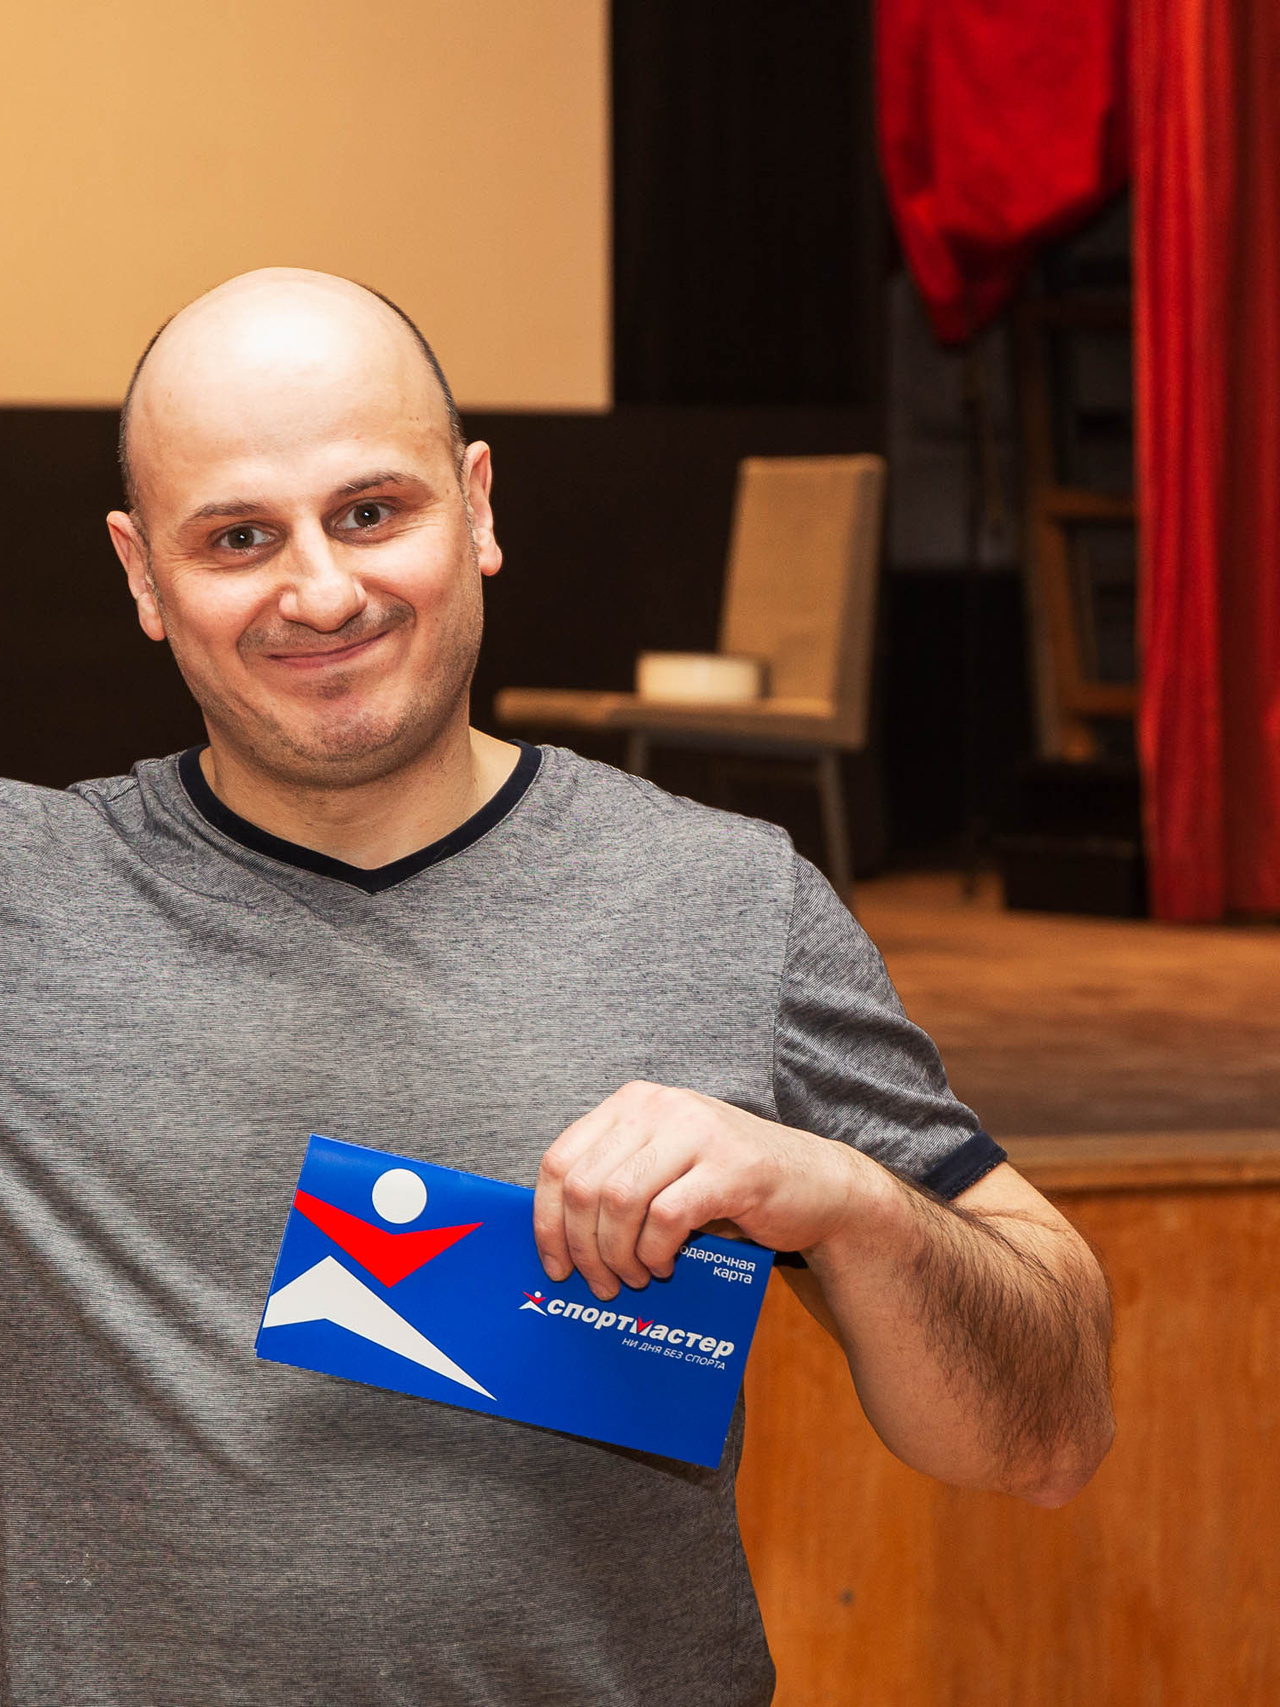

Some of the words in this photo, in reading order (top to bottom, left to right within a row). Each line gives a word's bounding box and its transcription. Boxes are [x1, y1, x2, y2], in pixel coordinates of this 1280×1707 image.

[679, 1245, 756, 1273] одарочная
[712, 1266, 753, 1285] карта
[546, 1298, 735, 1359] спортмастер
[621, 1337, 639, 1348] НИ
[638, 1342, 663, 1354] ДНЯ
[663, 1347, 684, 1360] БЕЗ
[684, 1353, 726, 1370] СПОРТА
